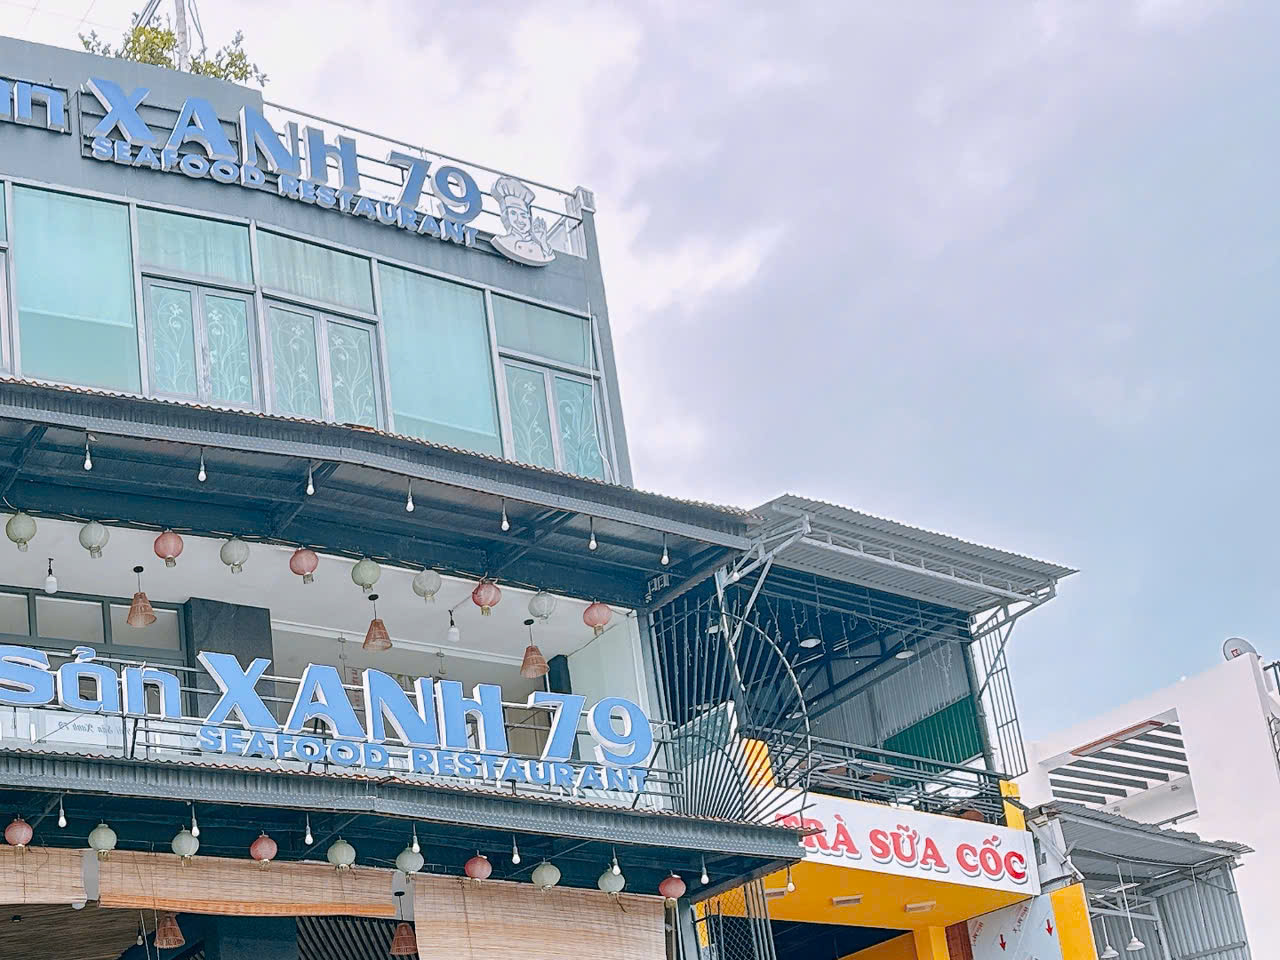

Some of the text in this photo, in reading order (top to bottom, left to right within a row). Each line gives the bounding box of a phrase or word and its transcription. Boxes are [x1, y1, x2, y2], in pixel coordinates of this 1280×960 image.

[86, 77, 360, 195] XANH
[386, 149, 483, 224] 79
[91, 135, 479, 247] SEAFOOD RESTAURANT
[196, 650, 509, 753] XANH
[527, 691, 655, 768] 79
[196, 726, 651, 793] SEAFOOD RESTAURANT
[869, 823, 948, 869] SỮA
[956, 835, 1027, 881] CỐC
